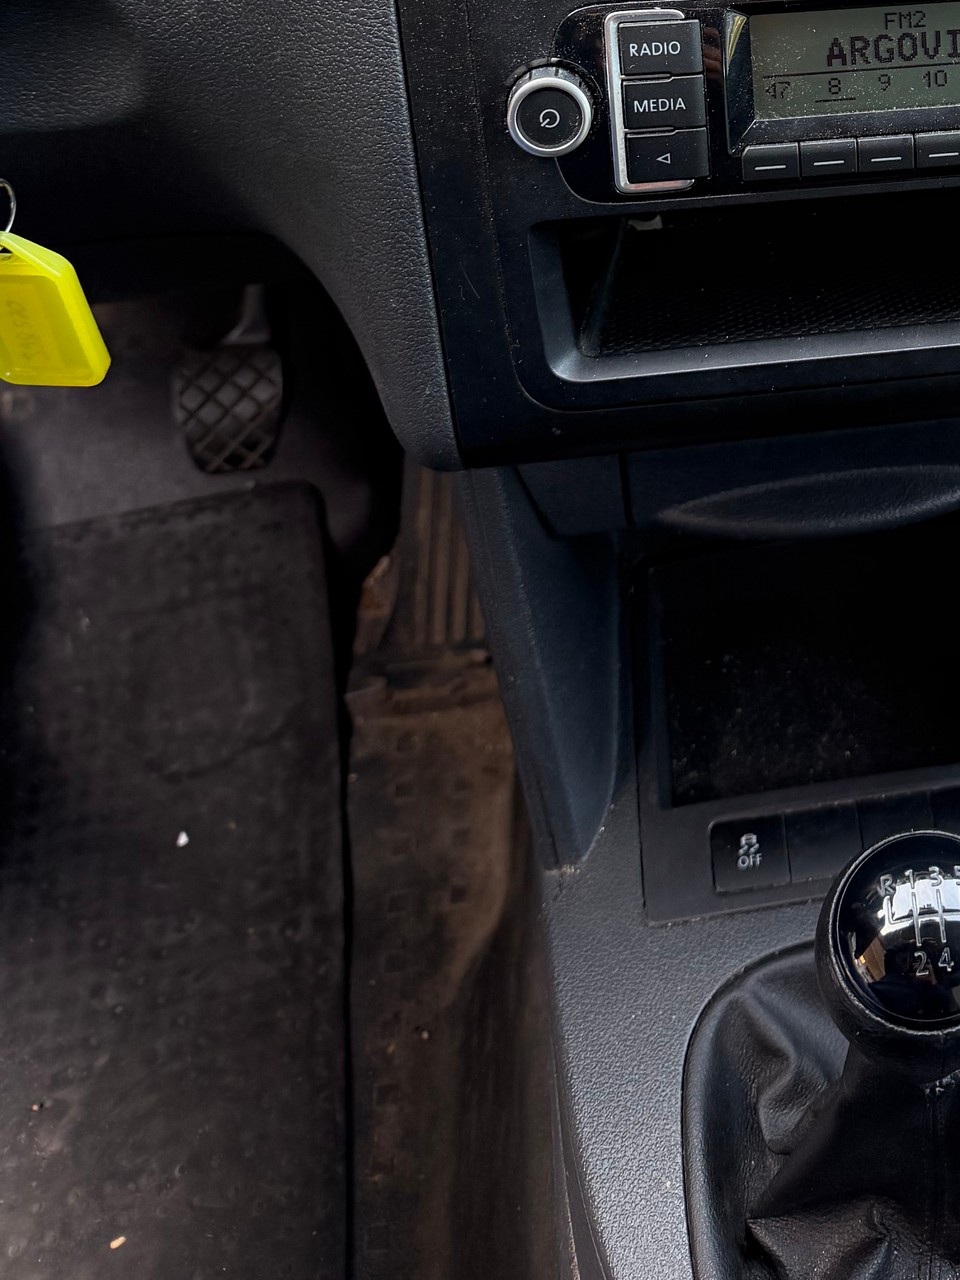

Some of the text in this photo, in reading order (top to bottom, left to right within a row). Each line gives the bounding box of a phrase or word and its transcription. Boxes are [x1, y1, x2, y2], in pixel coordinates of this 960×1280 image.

[884, 10, 926, 30] FM2
[629, 41, 681, 57] RADIO
[827, 77, 842, 95] 8
[878, 73, 892, 92] 9
[923, 70, 948, 89] 10
[633, 97, 687, 114] MEDIA
[737, 853, 763, 869] OFF
[928, 865, 944, 887] 3
[914, 947, 954, 976] 2 4
